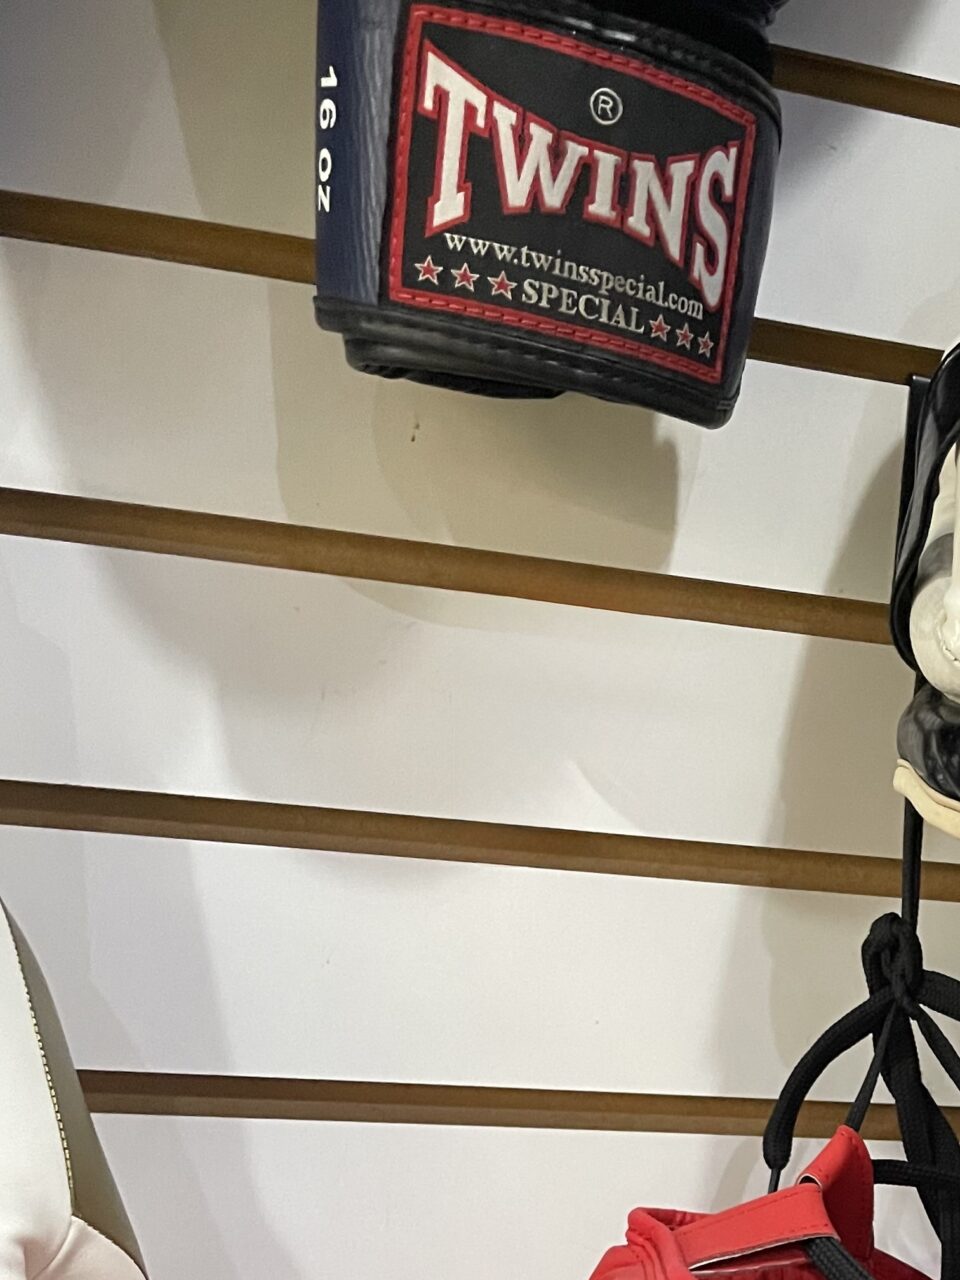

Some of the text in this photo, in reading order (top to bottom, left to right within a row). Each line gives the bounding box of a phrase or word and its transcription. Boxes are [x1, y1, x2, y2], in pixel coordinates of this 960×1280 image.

[317, 65, 338, 213] 16 OZ
[421, 48, 740, 310] TWINS
[443, 232, 704, 320] www.twinsspecial.com
[521, 278, 646, 334] SPECIAL
